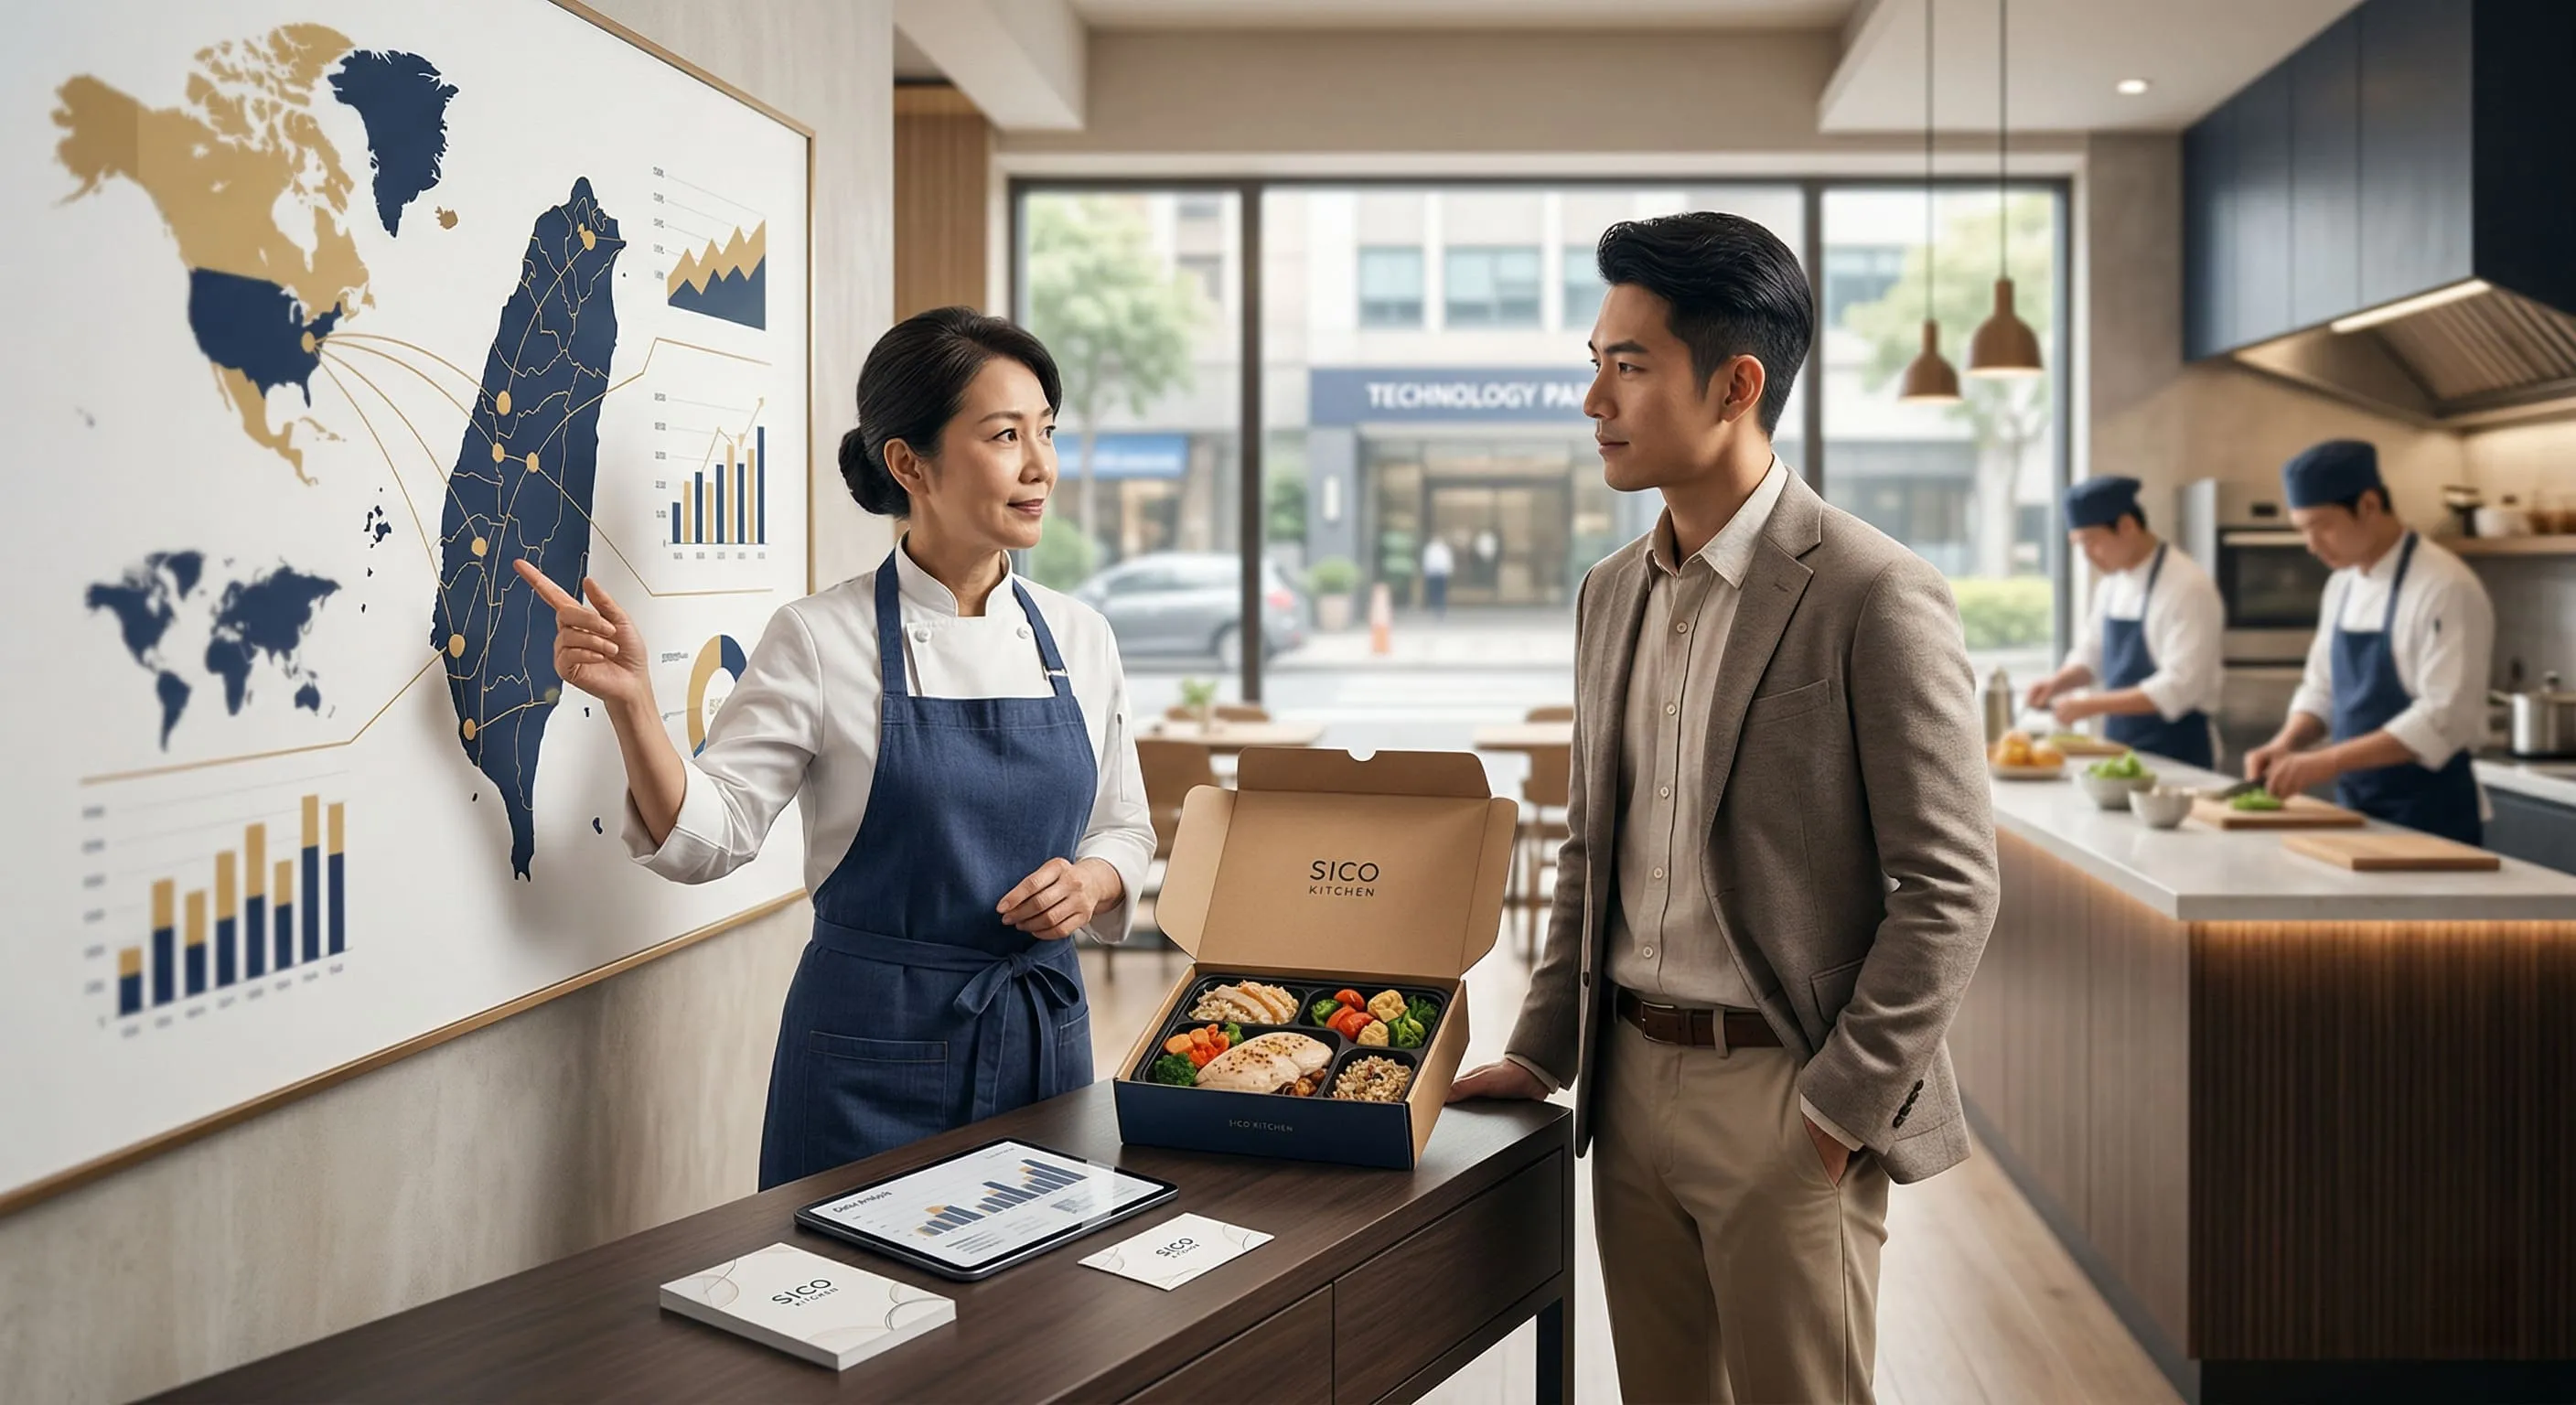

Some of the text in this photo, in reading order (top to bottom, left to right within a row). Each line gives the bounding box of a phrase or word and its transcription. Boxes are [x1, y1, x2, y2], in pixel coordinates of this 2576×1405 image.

[1365, 381, 1540, 409] TECHNOLOGY
[1309, 860, 1379, 883] SICO
[1309, 885, 1375, 897] KITCHEN
[1253, 1121, 1293, 1132] KITCHEN
[1155, 1238, 1194, 1257] SICO
[771, 1279, 832, 1304] SICO
